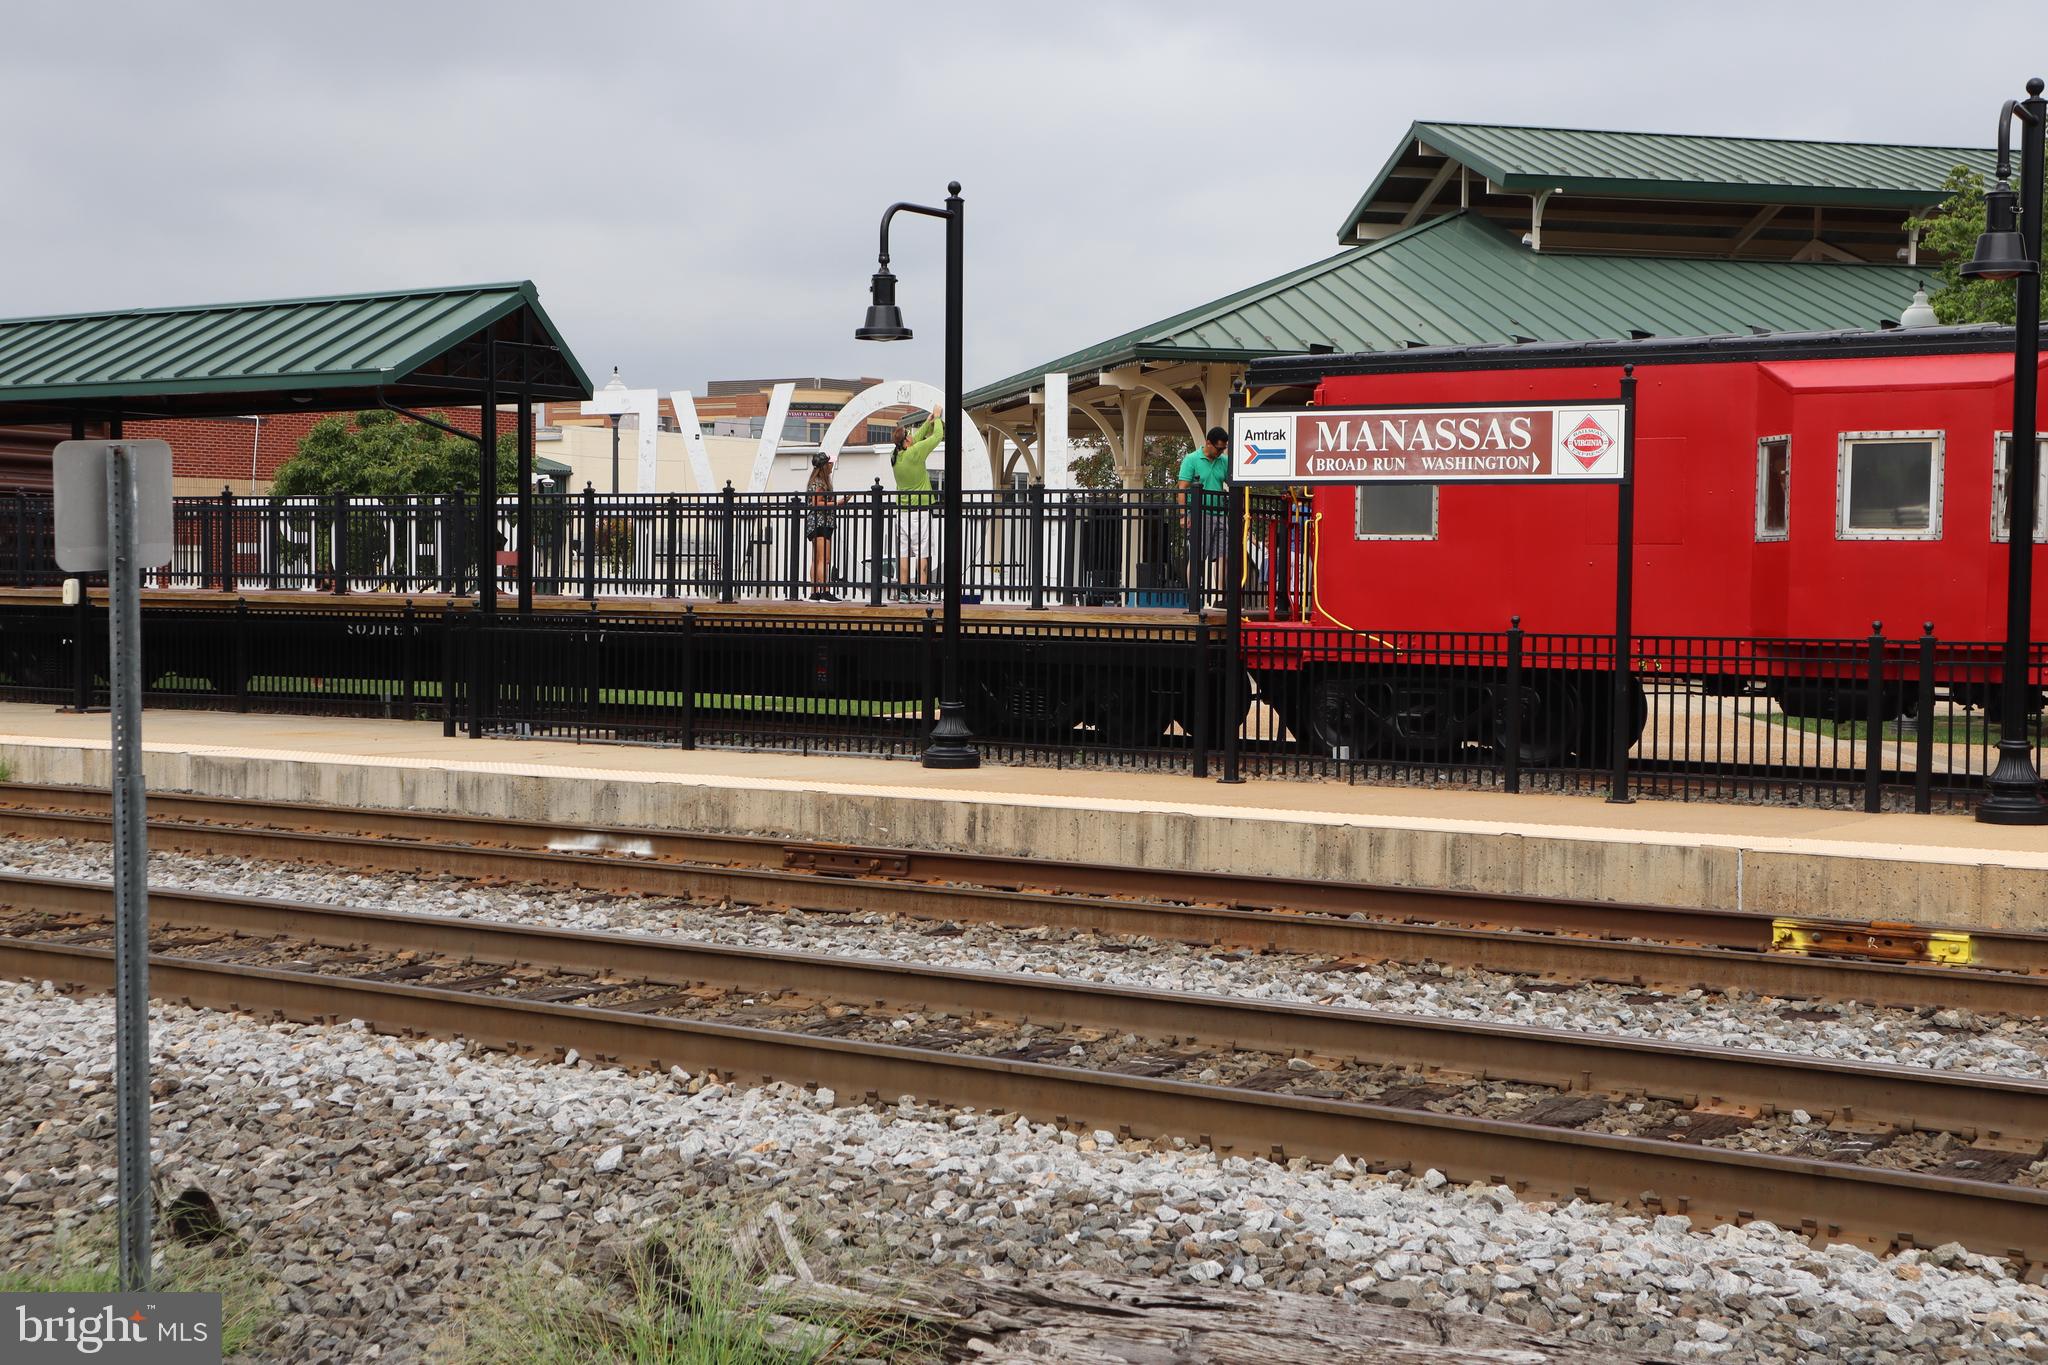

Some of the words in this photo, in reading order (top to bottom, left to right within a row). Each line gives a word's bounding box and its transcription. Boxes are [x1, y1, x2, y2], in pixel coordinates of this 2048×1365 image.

[1244, 429, 1286, 441] Amtrak
[1315, 416, 1532, 452] MANASSAS
[1573, 429, 1603, 437] RAILWAY
[1573, 439, 1601, 447] VIRGINIA
[1572, 448, 1604, 457] EXPRESS
[1315, 457, 1368, 471] BROAD
[1372, 457, 1406, 471] RUN
[1421, 455, 1531, 470] WASHINGTON
